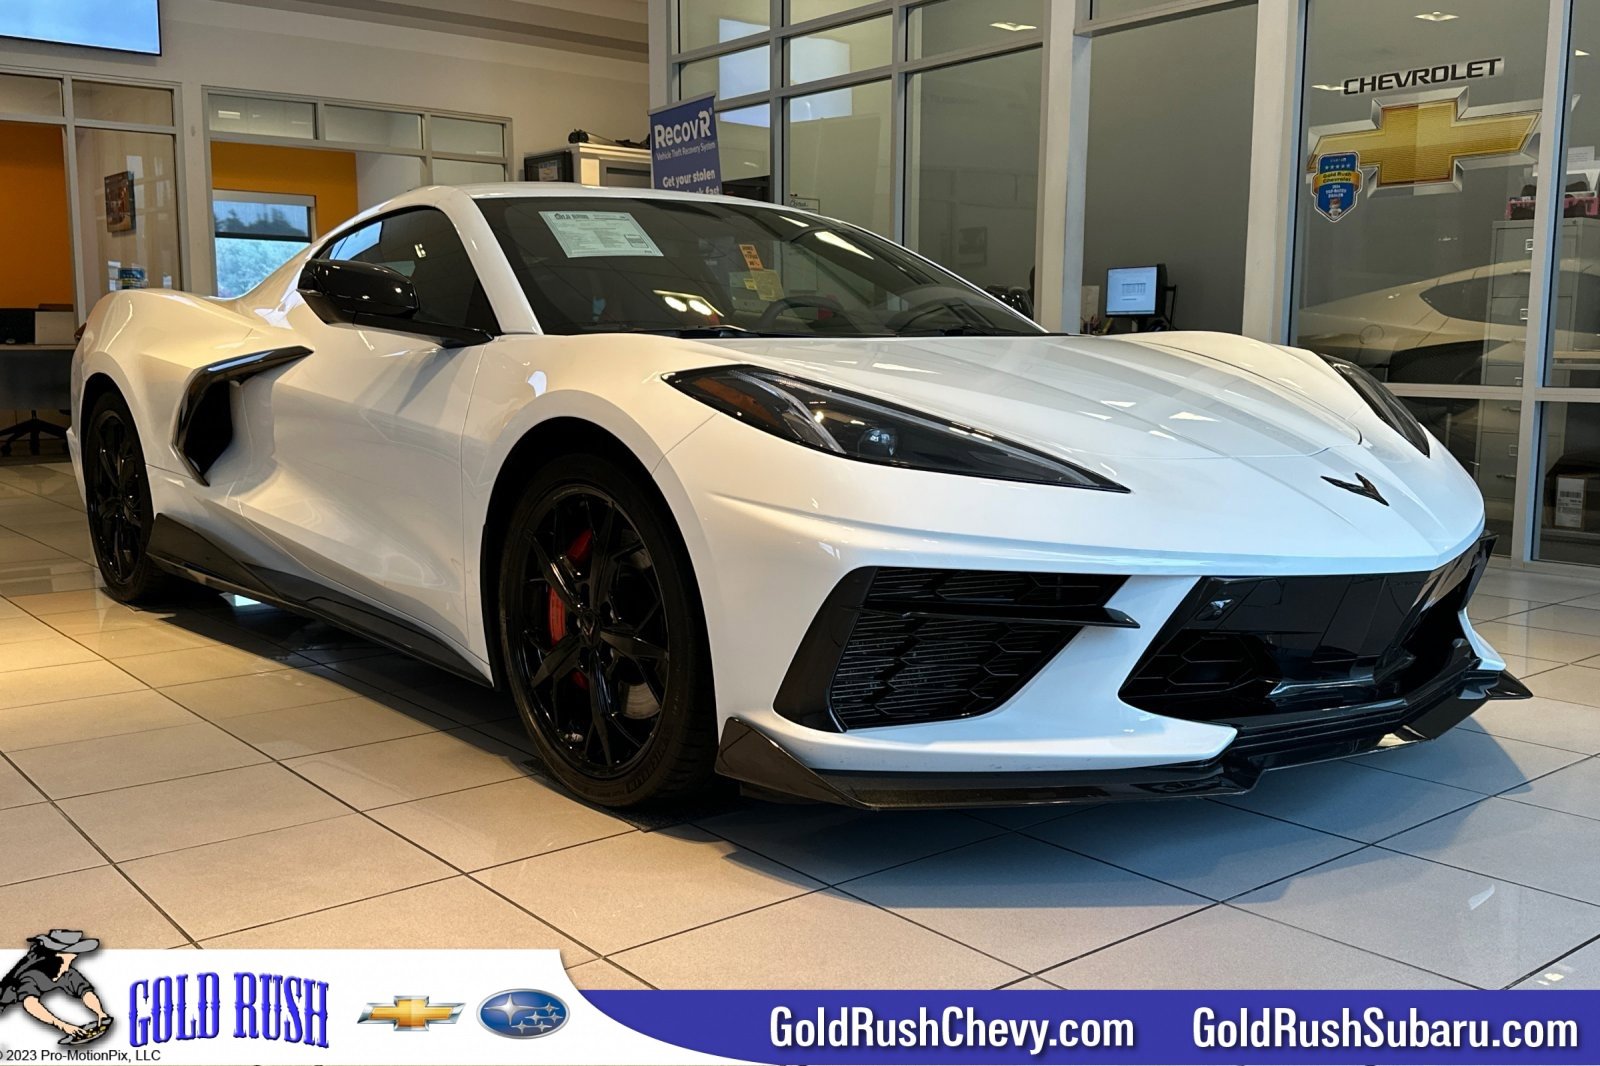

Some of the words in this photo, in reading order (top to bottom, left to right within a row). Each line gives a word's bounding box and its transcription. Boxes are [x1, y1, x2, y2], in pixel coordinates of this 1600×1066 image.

[1343, 57, 1502, 95] CHEVROLET
[656, 152, 672, 161] Vehicle
[671, 149, 682, 158] Theft
[682, 145, 700, 156] Recovery
[700, 141, 716, 152] System
[662, 176, 675, 188] Get
[675, 173, 692, 188] your
[692, 168, 716, 182] stolen
